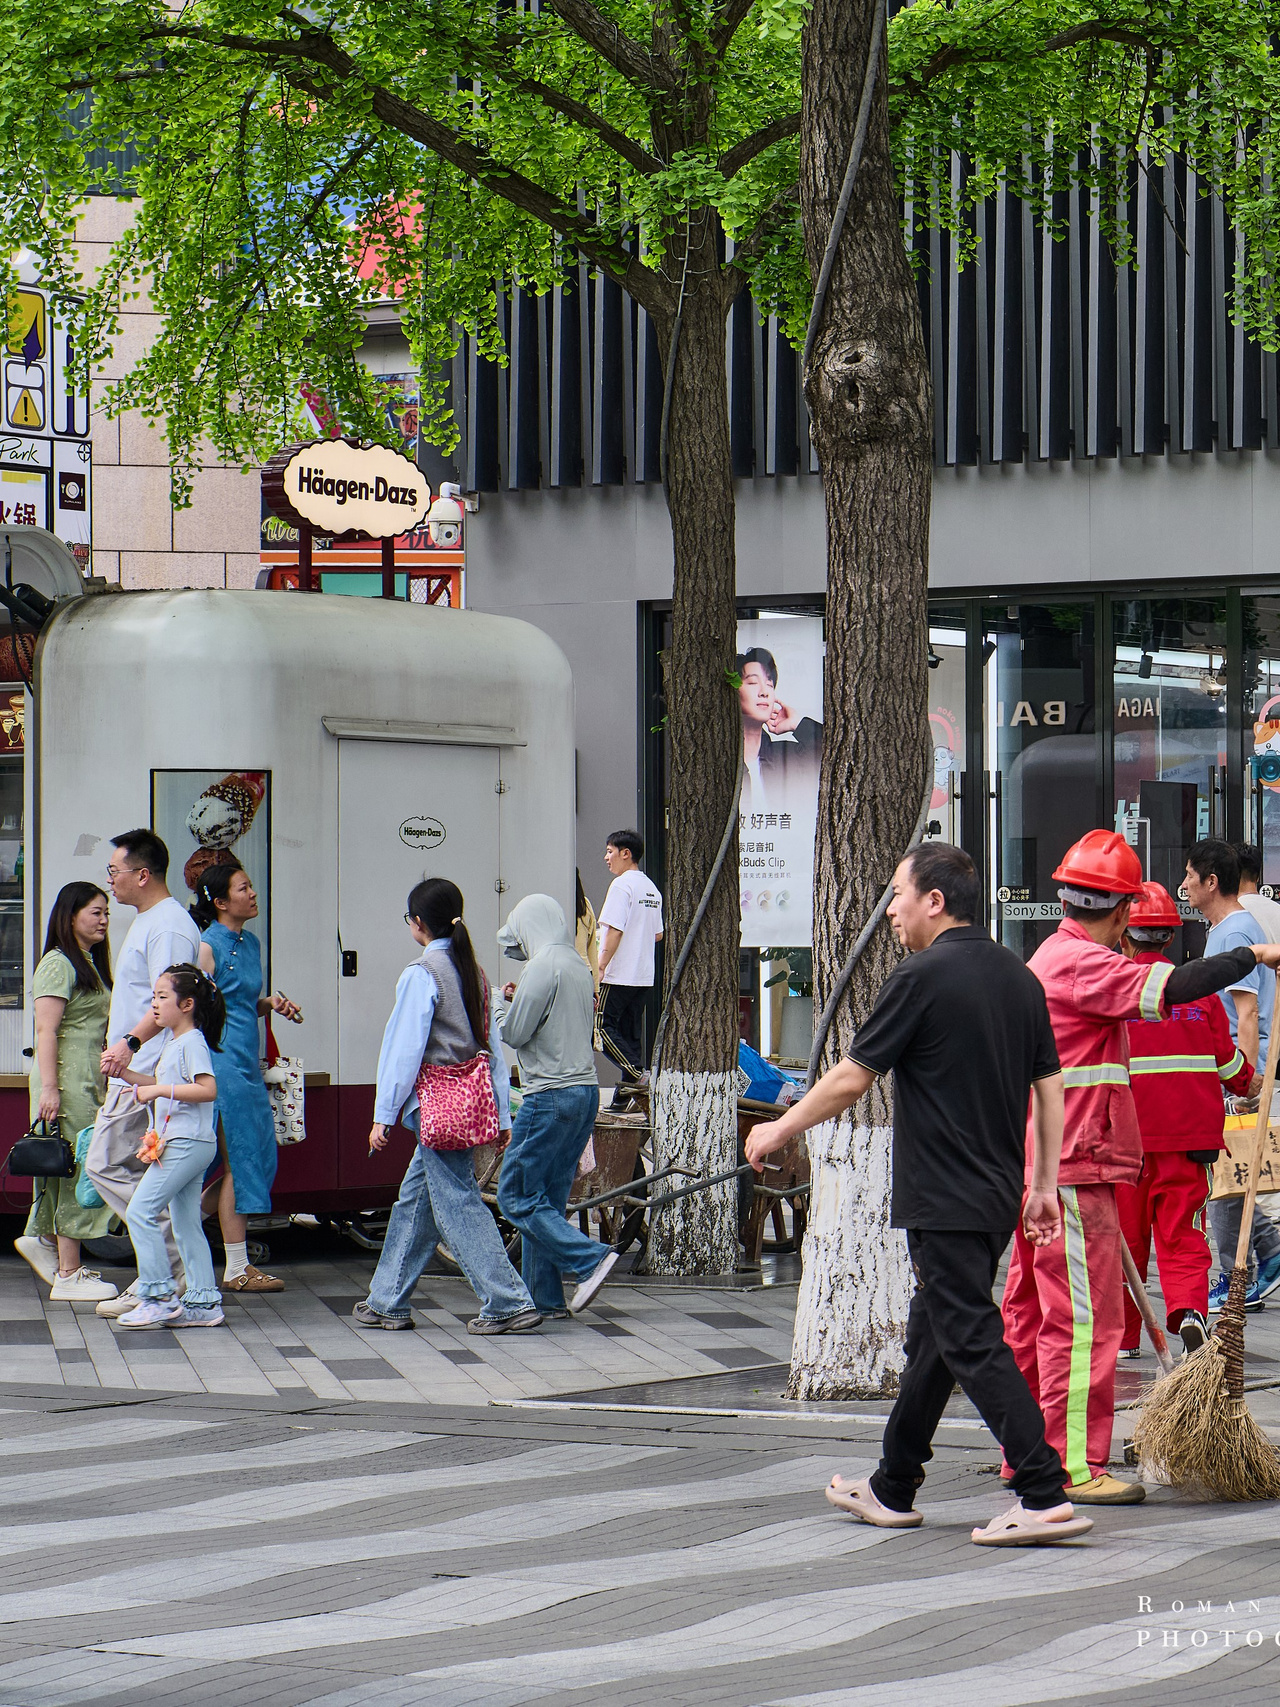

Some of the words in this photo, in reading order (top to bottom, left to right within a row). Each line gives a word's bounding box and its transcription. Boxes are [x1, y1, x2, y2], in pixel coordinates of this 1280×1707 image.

[298, 466, 418, 505] Häagen-Dazs
[750, 813, 792, 829] 好声音
[403, 827, 442, 838] Häagen-Dazs
[768, 857, 785, 869] Clip
[999, 889, 1009, 899] 拉
[1004, 904, 1037, 918] Sony
